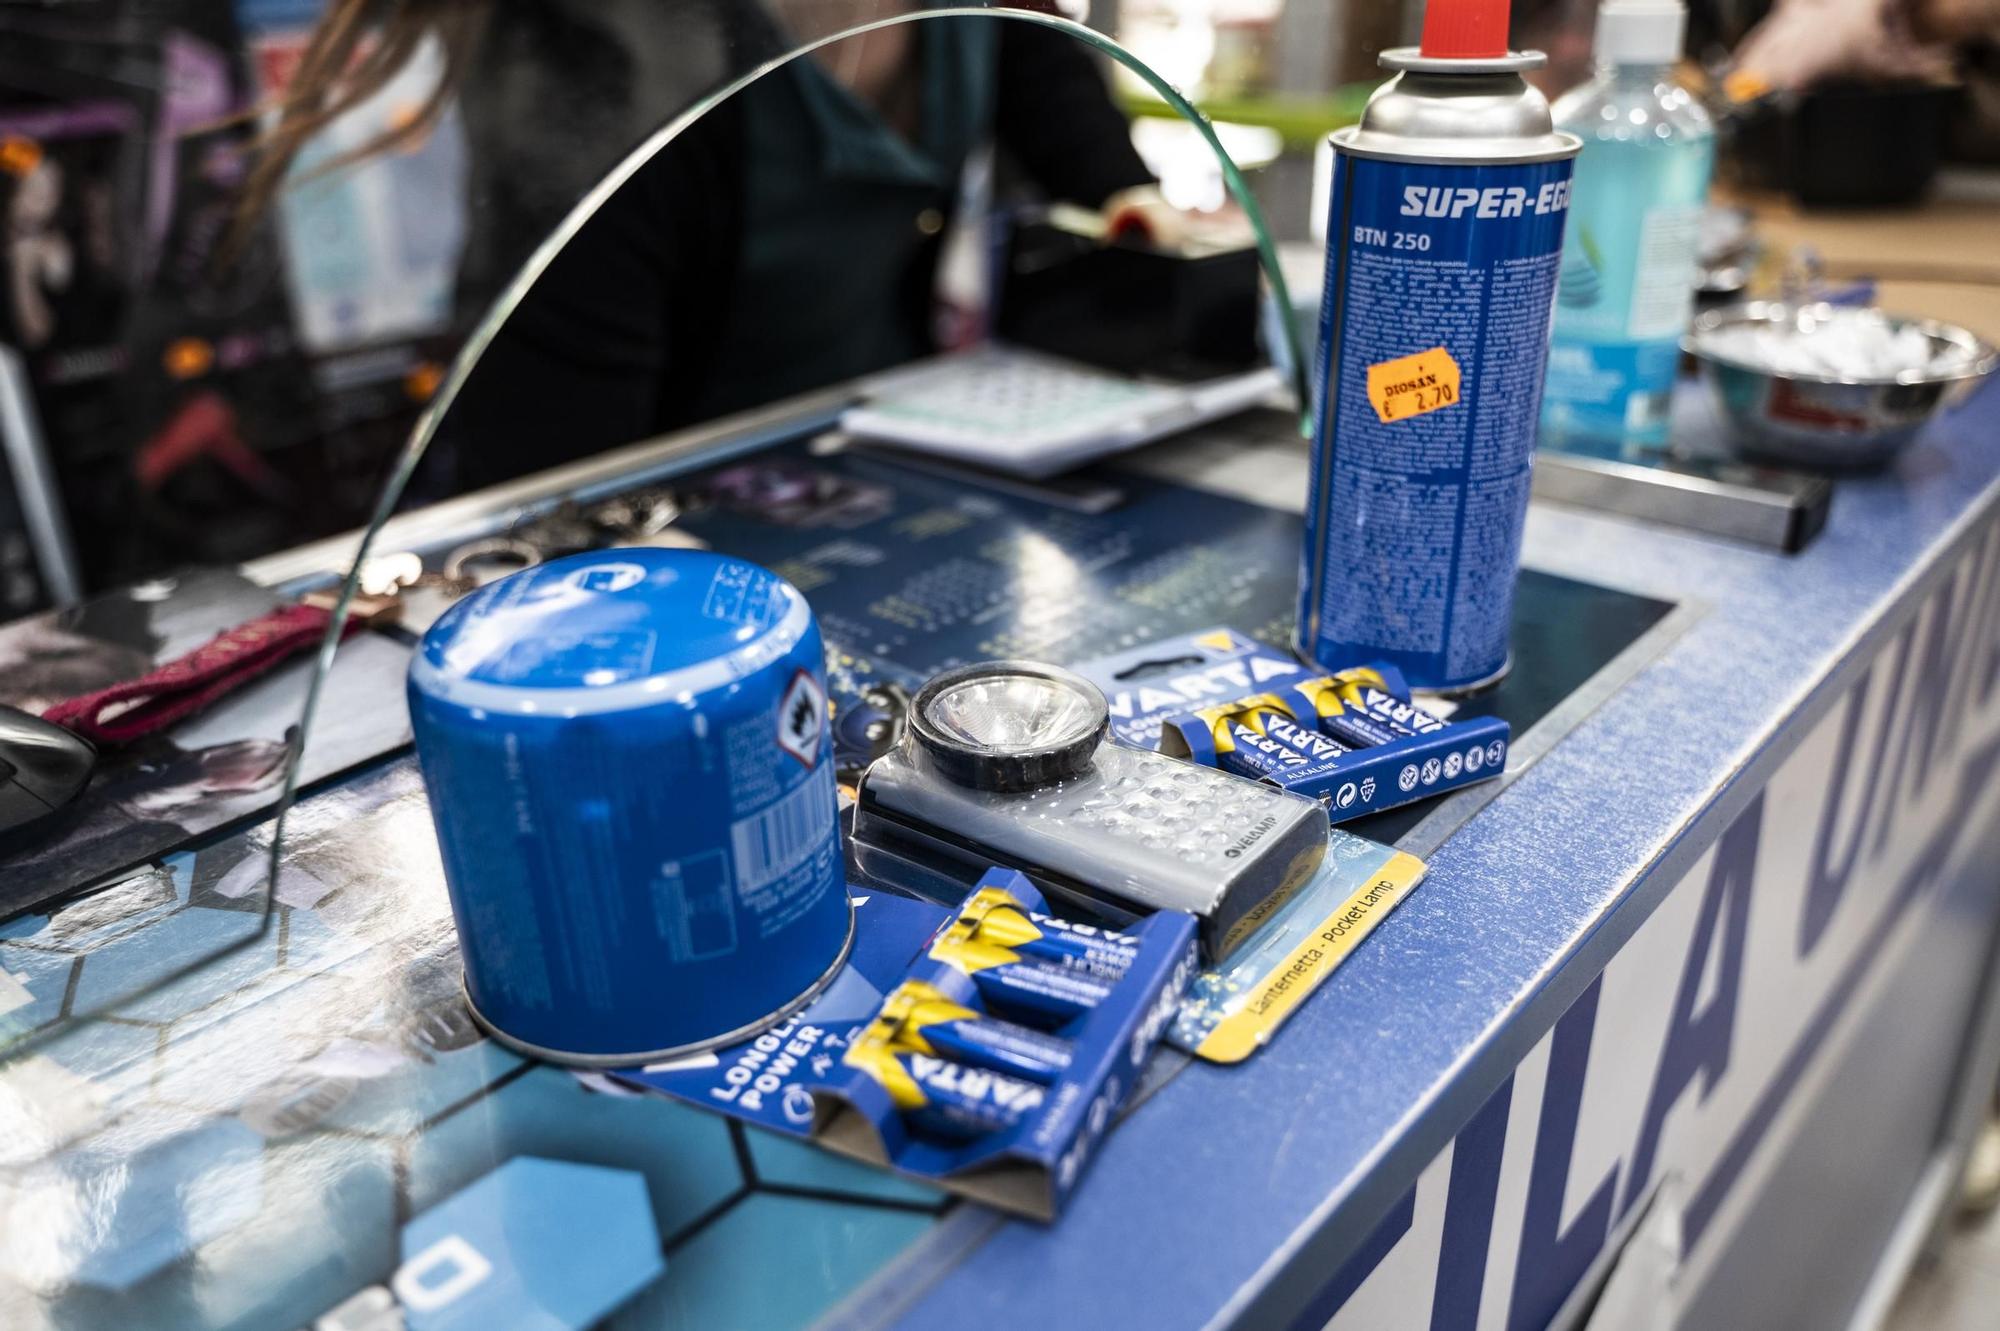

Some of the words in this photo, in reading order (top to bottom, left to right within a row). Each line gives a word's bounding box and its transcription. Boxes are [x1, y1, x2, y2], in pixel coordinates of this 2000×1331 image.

[1354, 226, 1387, 247] BTN
[1393, 233, 1431, 251] 250
[1415, 384, 1453, 411] 2.70
[1109, 656, 1299, 718] VARTA
[1366, 688, 1442, 733] VARTA
[1234, 724, 1308, 764] VARTA
[1267, 714, 1342, 760] VARTA
[1287, 762, 1339, 781] ALKALINE
[1247, 948, 1325, 1015] Lanternetta
[1322, 906, 1368, 944] Pocket
[1357, 880, 1395, 907] Lamp
[710, 1010, 807, 1101] LONGL
[739, 1025, 825, 1111] POWER
[911, 1053, 1045, 1113] VARTA
